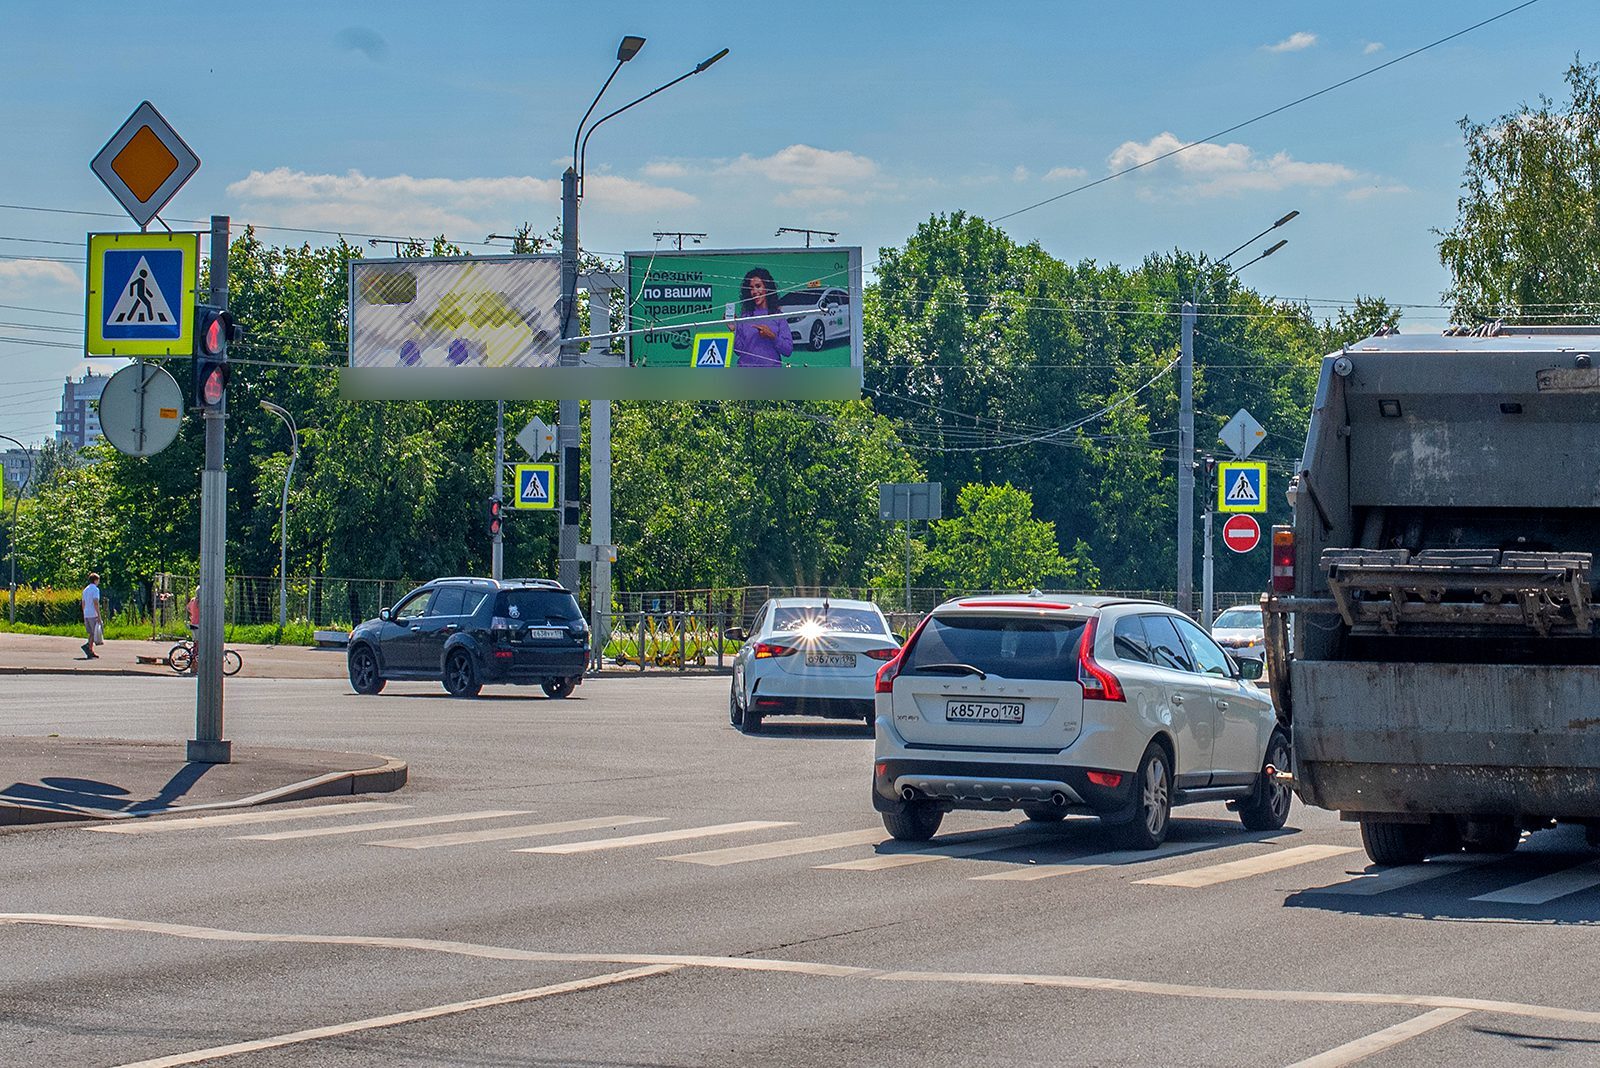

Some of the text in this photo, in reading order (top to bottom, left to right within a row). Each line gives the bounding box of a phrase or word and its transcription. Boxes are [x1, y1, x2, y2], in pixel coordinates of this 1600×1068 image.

[644, 287, 712, 299] по вашим
[644, 304, 713, 318] правилам
[951, 704, 1020, 718] К857РО 178
